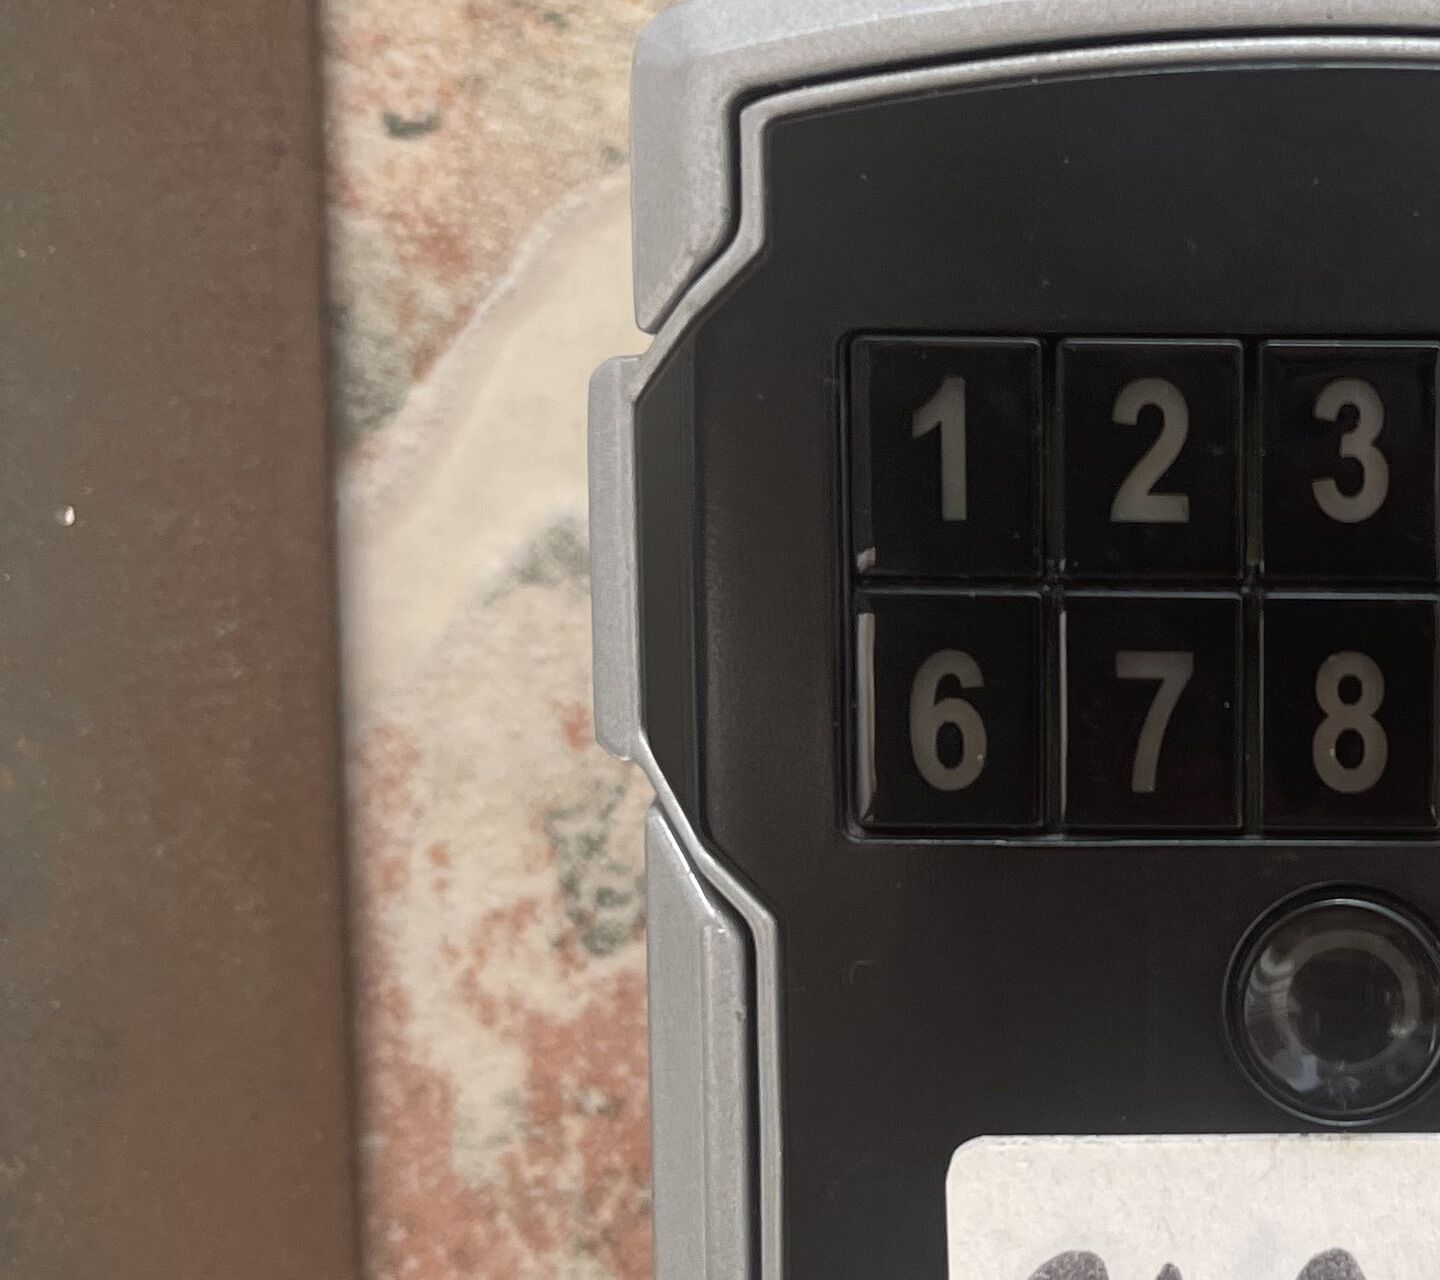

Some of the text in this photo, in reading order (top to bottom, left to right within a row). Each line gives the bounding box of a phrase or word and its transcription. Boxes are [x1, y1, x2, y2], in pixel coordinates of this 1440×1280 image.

[912, 375, 968, 521] 1
[1110, 377, 1191, 522] 2
[1312, 378, 1390, 522] 3
[909, 648, 987, 793] 6
[1115, 650, 1194, 793] 7
[1312, 650, 1389, 794] 8
